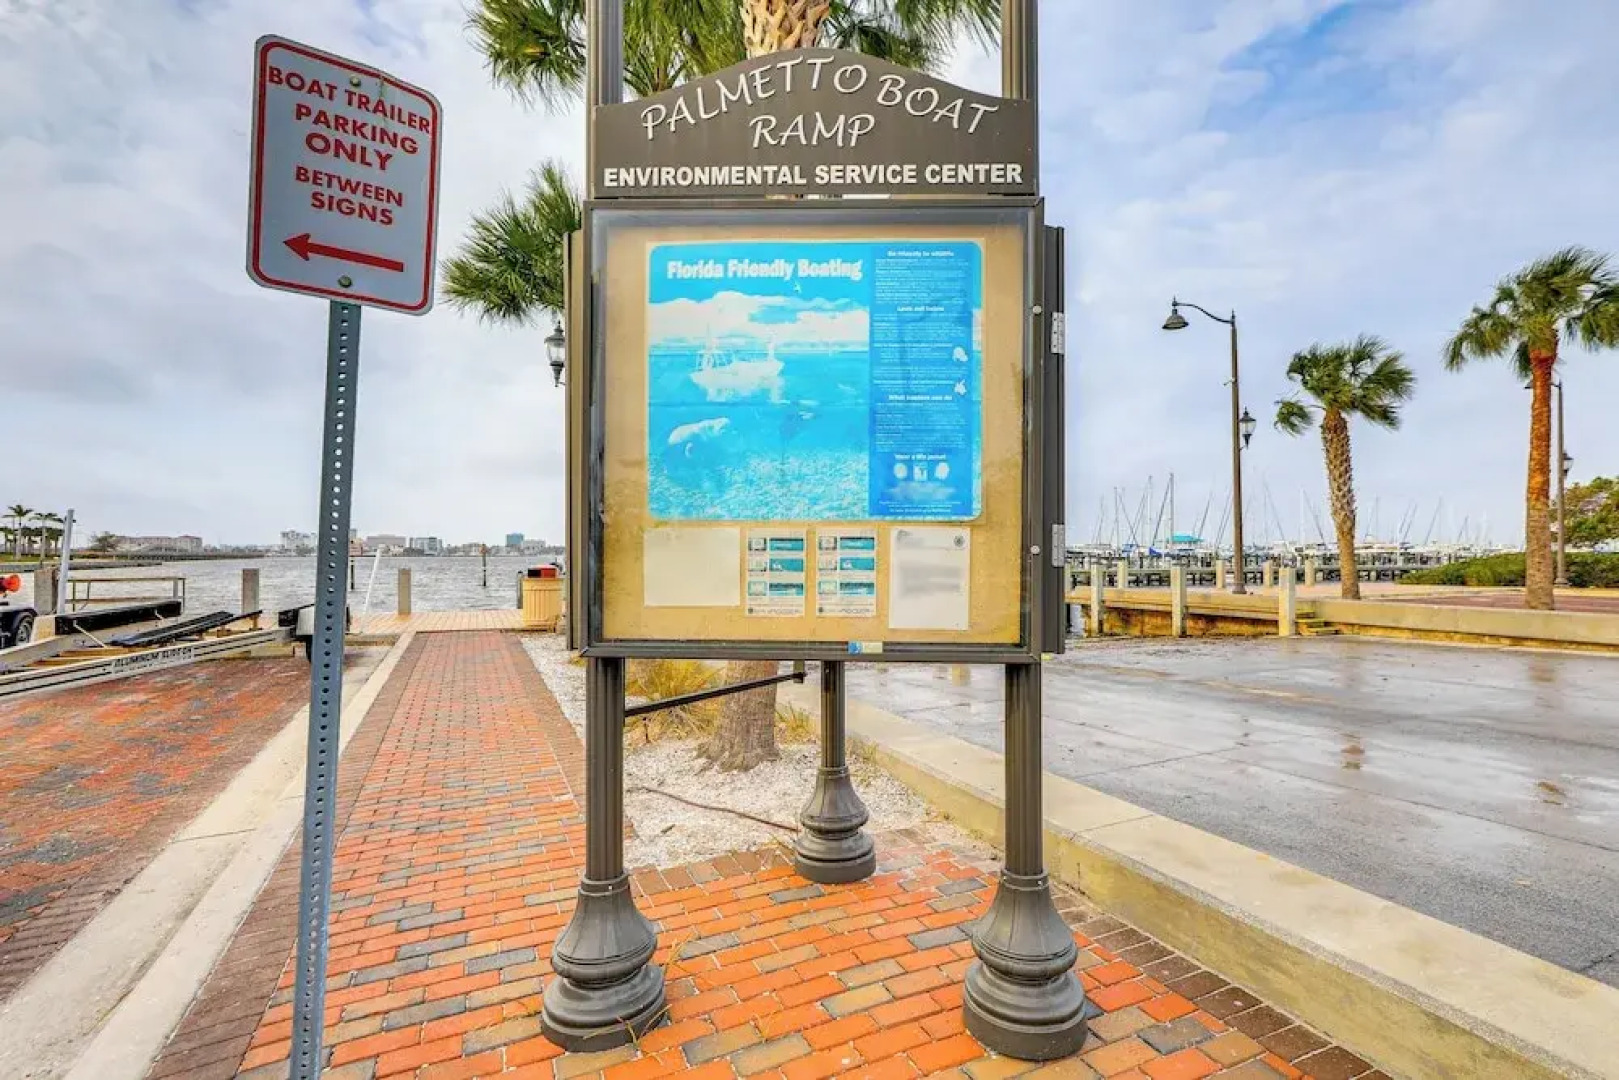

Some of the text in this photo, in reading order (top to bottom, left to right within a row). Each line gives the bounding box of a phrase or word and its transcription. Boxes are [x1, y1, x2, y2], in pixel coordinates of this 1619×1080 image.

[268, 66, 430, 134] BOAT TRAILER
[641, 55, 999, 140] PALMETTO BOAT
[295, 103, 419, 154] PARKING
[749, 111, 876, 148] RAMP
[305, 132, 393, 171] ONLY
[295, 165, 403, 207] BETWEEN
[603, 163, 1023, 187] ENVIRONMENTAL SERVICE CENTER
[310, 191, 393, 226] SIGNS
[666, 259, 724, 280] Florida
[727, 258, 796, 281] Friendly
[797, 258, 864, 282] Boating
